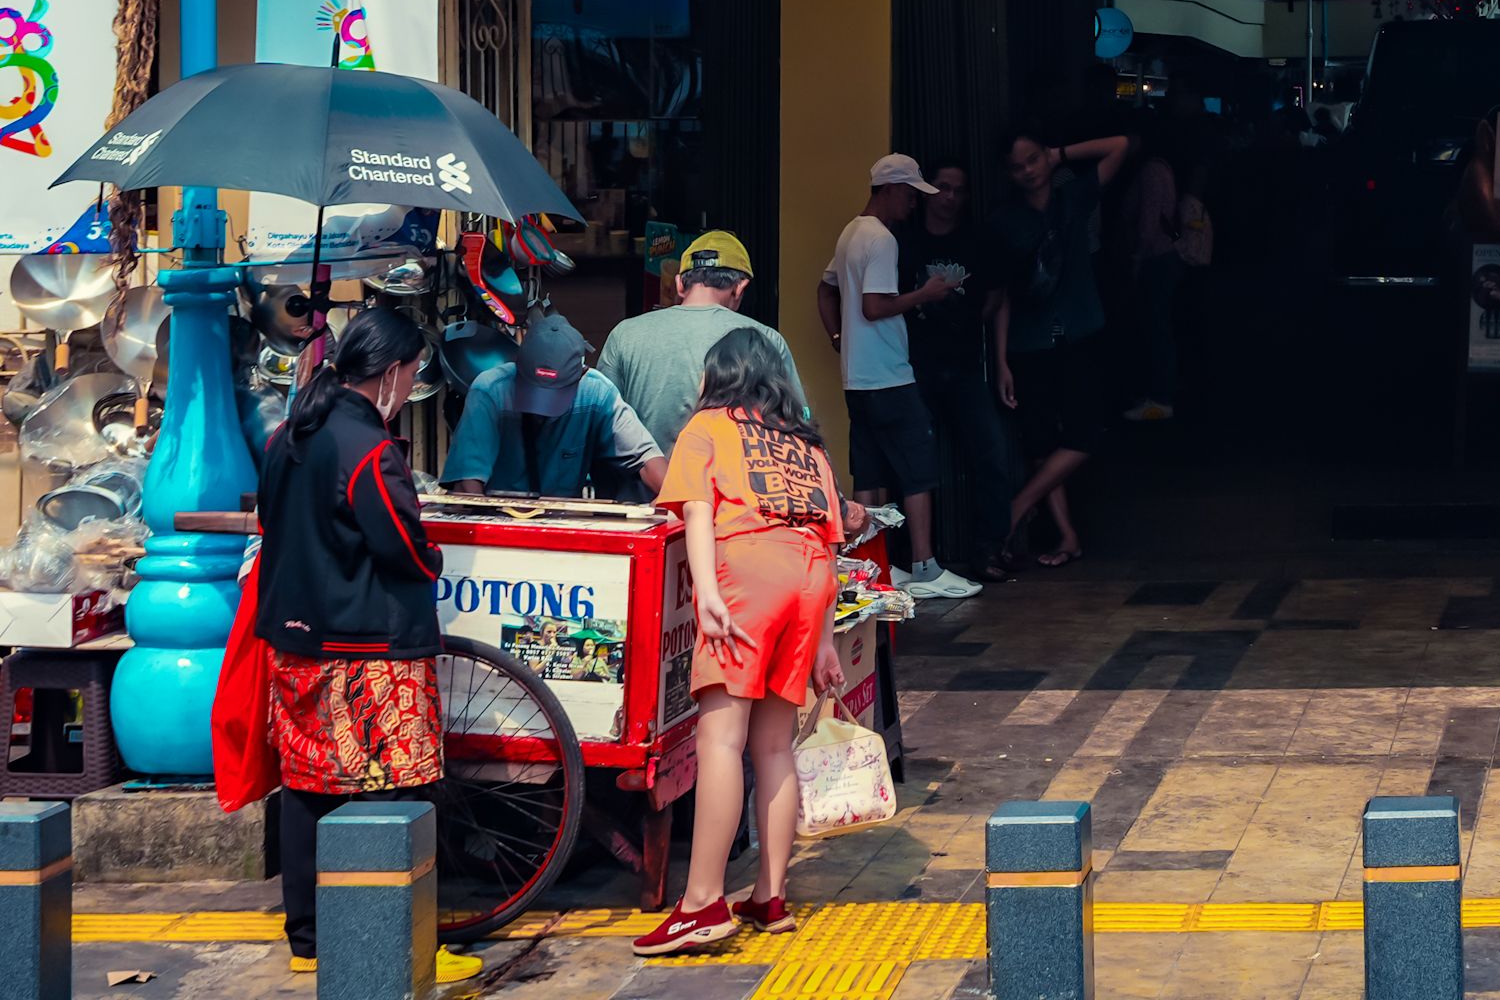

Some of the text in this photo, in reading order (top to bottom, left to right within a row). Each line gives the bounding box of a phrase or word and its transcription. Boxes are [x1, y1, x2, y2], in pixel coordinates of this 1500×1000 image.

[348, 165, 435, 187] Chartered
[350, 149, 431, 170] Standard
[742, 438, 821, 479] HEAR
[433, 576, 595, 620] POTONG
[662, 617, 698, 662] POTON
